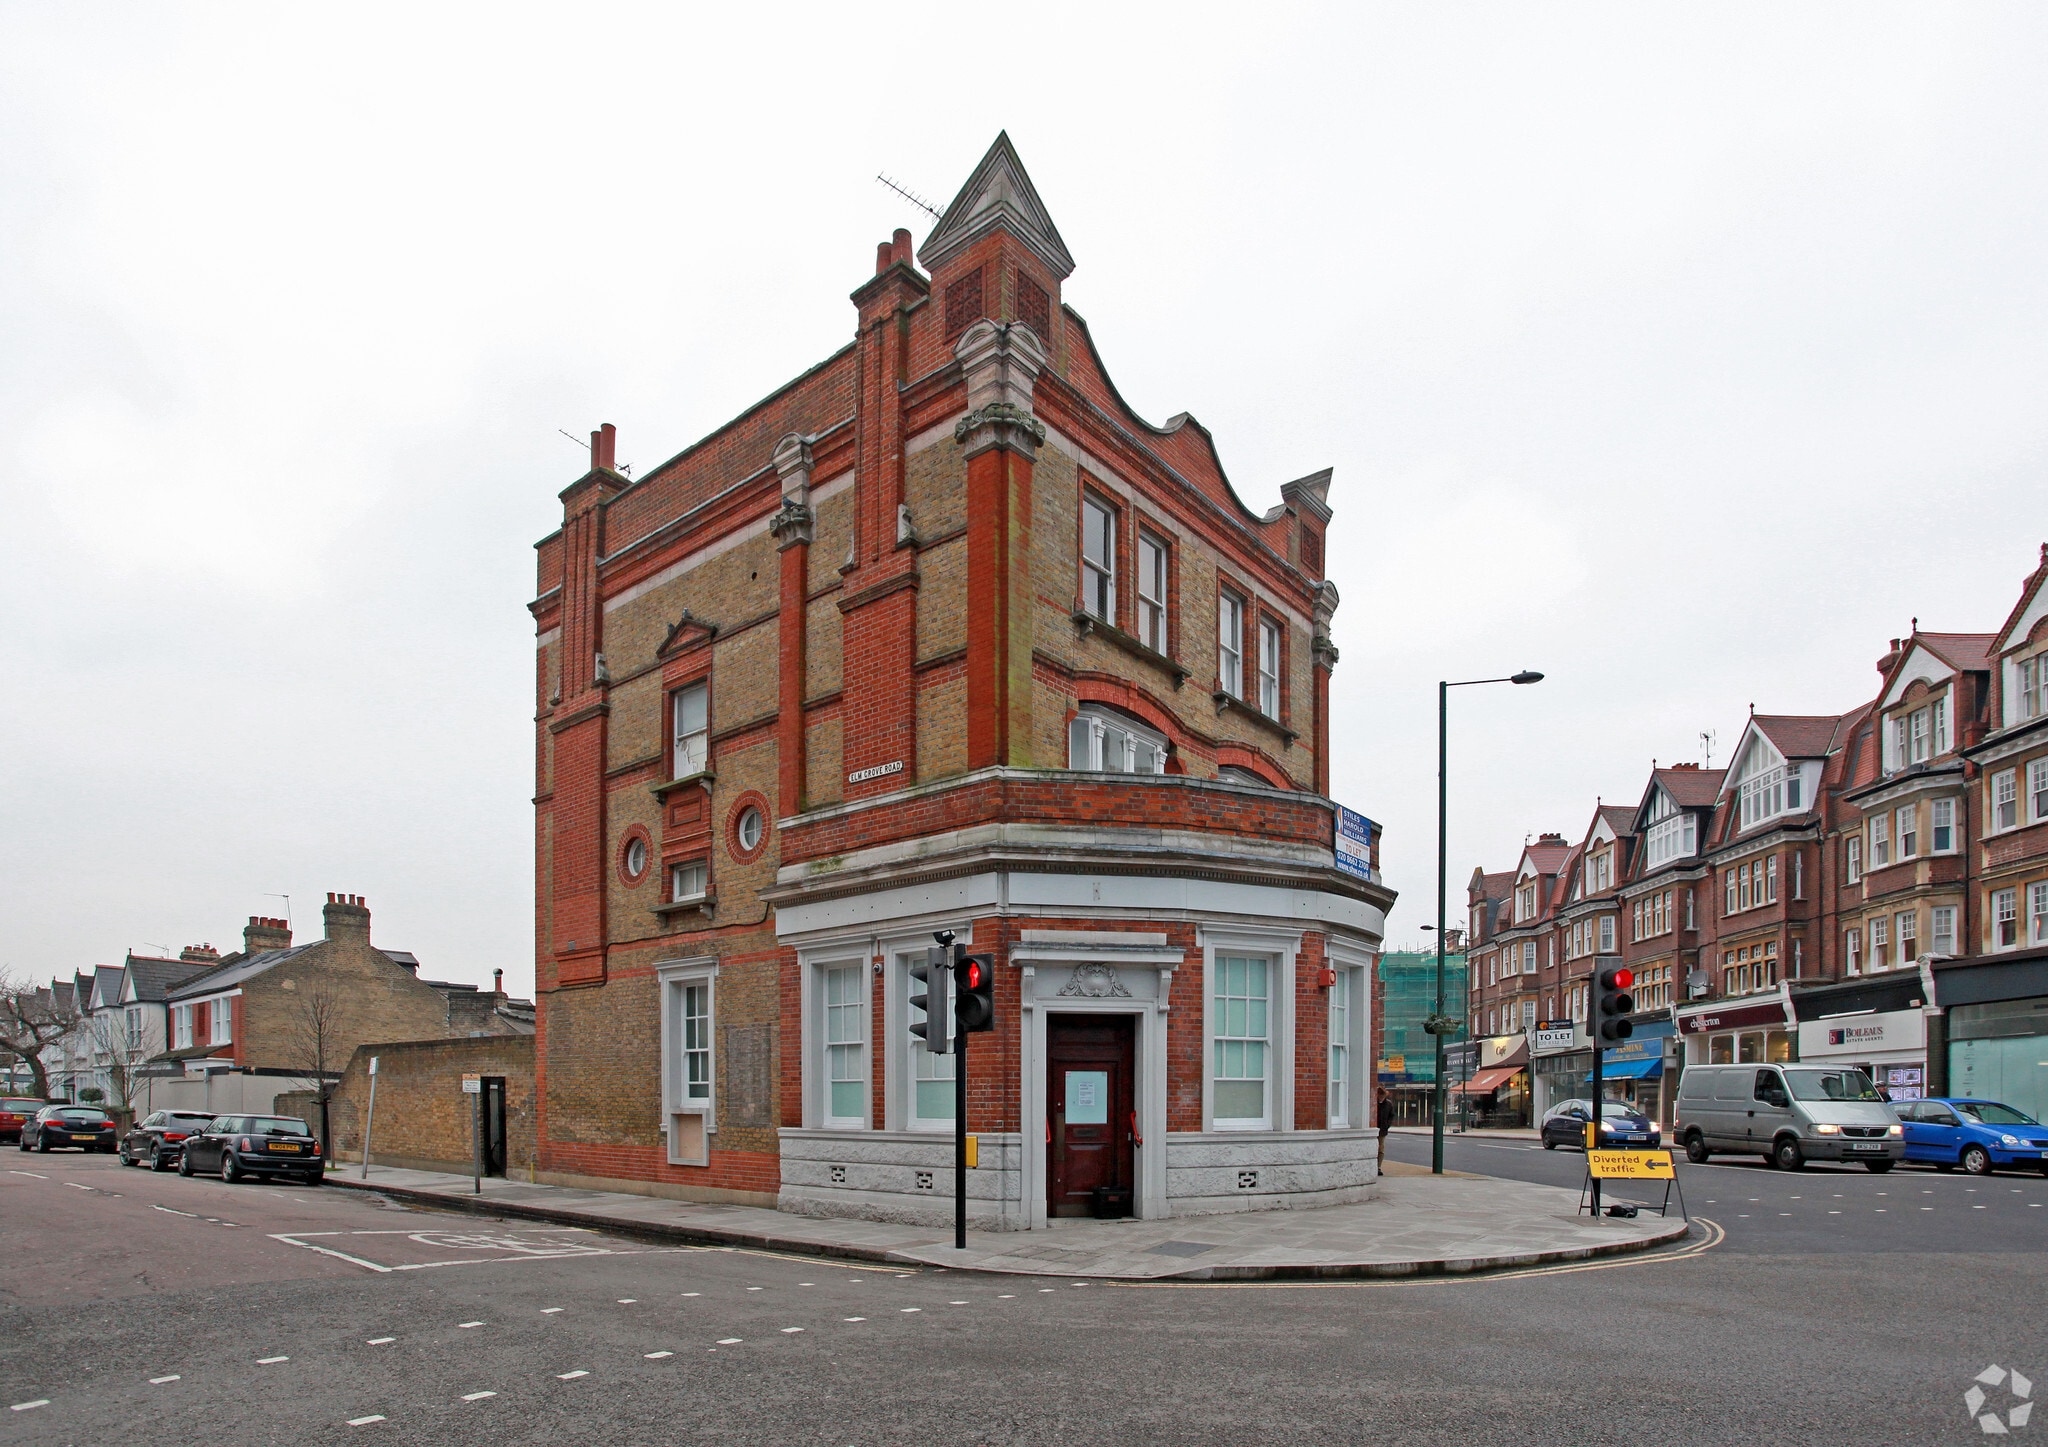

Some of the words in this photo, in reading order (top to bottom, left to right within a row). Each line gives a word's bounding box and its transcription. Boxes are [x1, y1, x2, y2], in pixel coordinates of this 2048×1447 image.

[851, 773, 862, 782] ELM
[864, 766, 883, 778] GROVE
[885, 762, 900, 773] ROAD
[1344, 810, 1360, 823] STILES
[1344, 819, 1364, 834] HAROLD
[1344, 828, 1367, 844] WILLIAMS
[1345, 843, 1353, 854] TO
[1352, 847, 1362, 858] LET
[1690, 1018, 1720, 1029] chesterton
[1601, 1165, 1635, 1173] traffic
